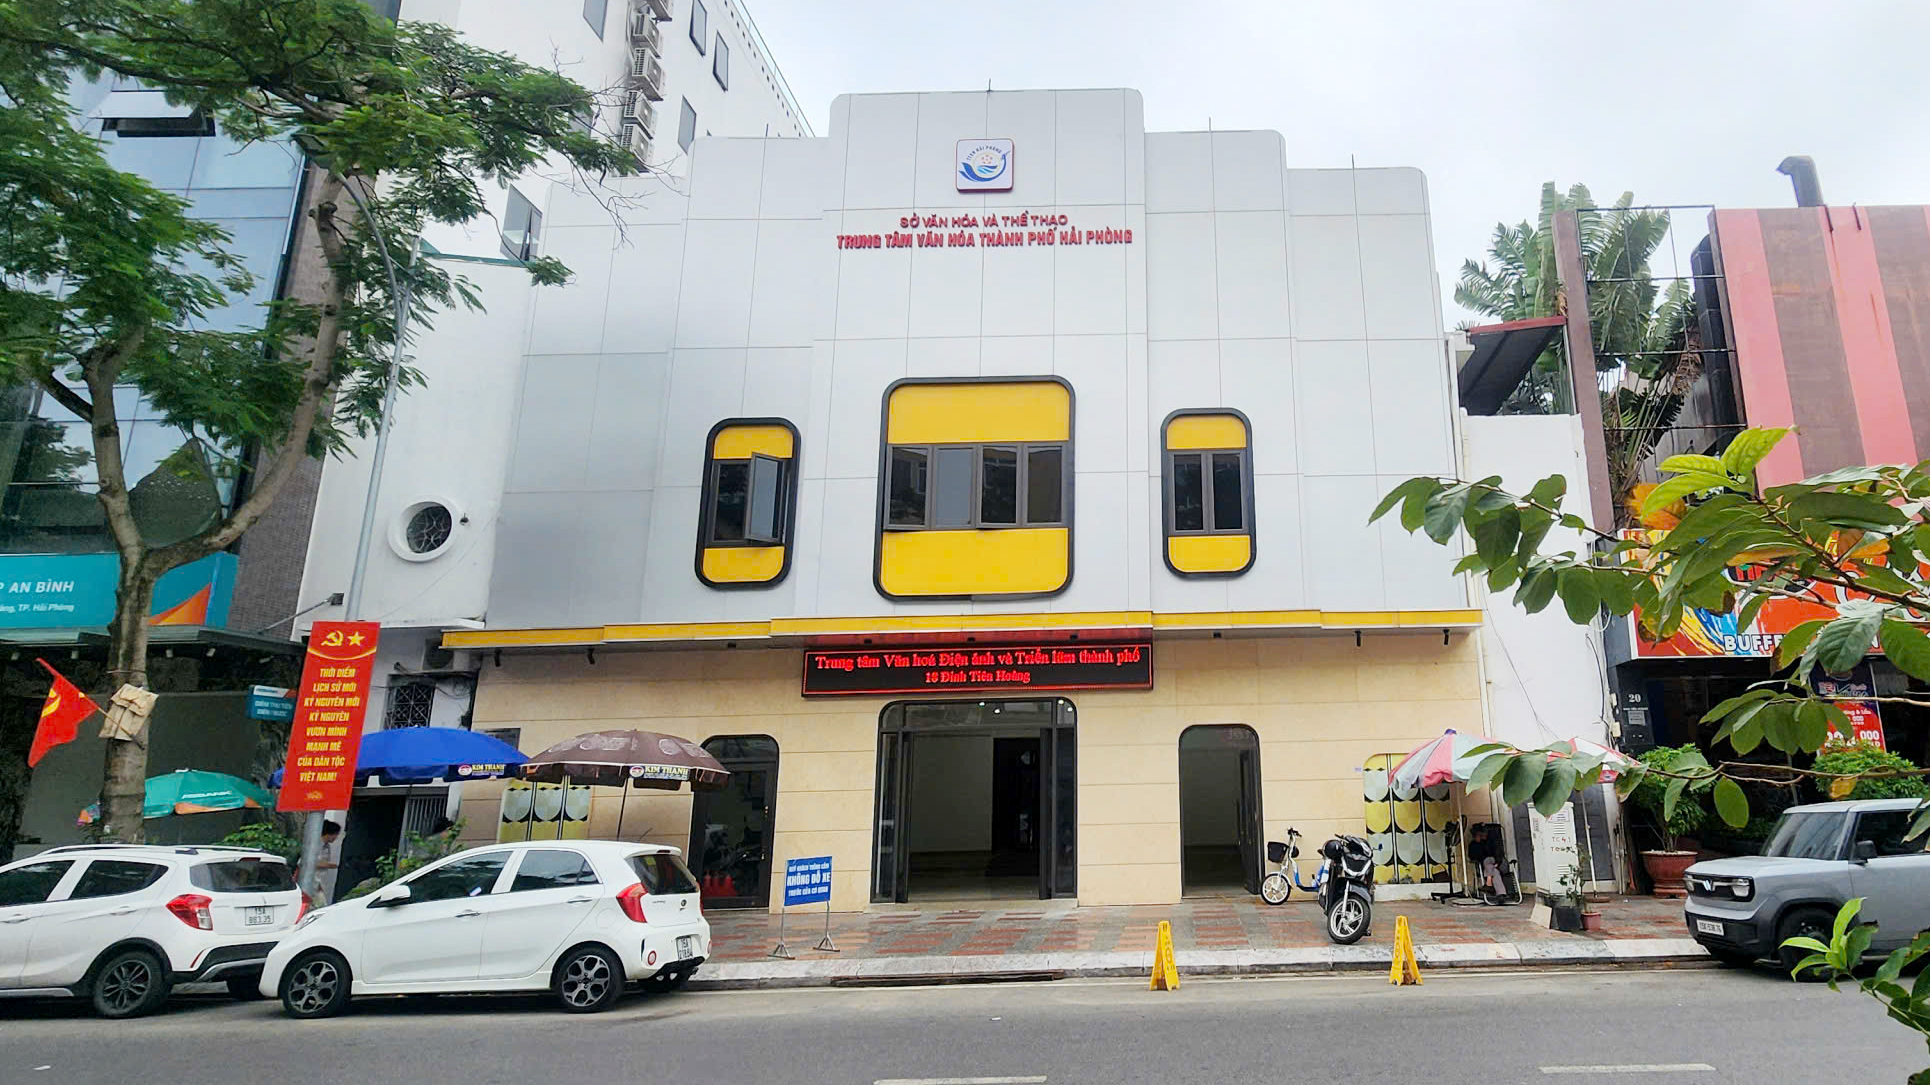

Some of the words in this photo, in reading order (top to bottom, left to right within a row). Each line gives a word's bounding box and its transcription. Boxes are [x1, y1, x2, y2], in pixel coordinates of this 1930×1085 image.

[900, 213, 920, 228] SỞ
[922, 214, 948, 228] VĂN
[951, 213, 979, 228] HÓA
[982, 213, 999, 227] VÀ
[1030, 214, 1068, 227] THAO
[836, 234, 881, 249] TRUNG
[885, 230, 913, 248] TÂM
[917, 230, 944, 248] VĂN
[947, 230, 975, 248] HÓA
[979, 230, 1023, 247] THÀNH
[1028, 226, 1057, 246] PHỐ
[1060, 226, 1082, 245] HẢI
[1086, 226, 1132, 245] PHÒNG
[8, 582, 31, 593] AN
[35, 579, 75, 593] BÌNH
[815, 656, 854, 671] Trung
[856, 655, 880, 668] tâm
[884, 654, 910, 668] Văn
[938, 651, 969, 668] Điện
[971, 651, 995, 666] ánh
[997, 652, 1013, 665] và
[1015, 647, 1050, 665] Triển
[1051, 649, 1076, 664] lãm
[1079, 648, 1114, 664] thành
[1116, 646, 1141, 666] phố
[320, 666, 335, 678] THỜI
[336, 665, 356, 678] ĐIỂM
[940, 671, 967, 683] Đinh
[969, 670, 994, 682] Tiên
[995, 669, 1031, 683] Hoàng
[313, 682, 330, 693] LỊCH
[330, 680, 342, 692] SỬ
[342, 681, 357, 692] MỚI
[315, 696, 345, 707] NGUYÊN
[345, 696, 360, 707] MỚI
[1628, 693, 1641, 703] 20
[320, 711, 349, 721] NGUYÊN
[306, 726, 326, 736] VƯƠN
[327, 726, 347, 736] MÌNH
[306, 742, 329, 753] MẠNH
[297, 755, 312, 766] CỦA
[314, 755, 330, 766] DÂN
[331, 755, 345, 768] TỘC
[645, 765, 660, 773] KIM
[661, 766, 689, 775] THANH
[300, 771, 316, 784] VIỆT
[317, 772, 337, 782] NAM!
[787, 872, 810, 886] KHÔNG
[811, 869, 821, 884] ĐỖ
[822, 872, 831, 883] XE
